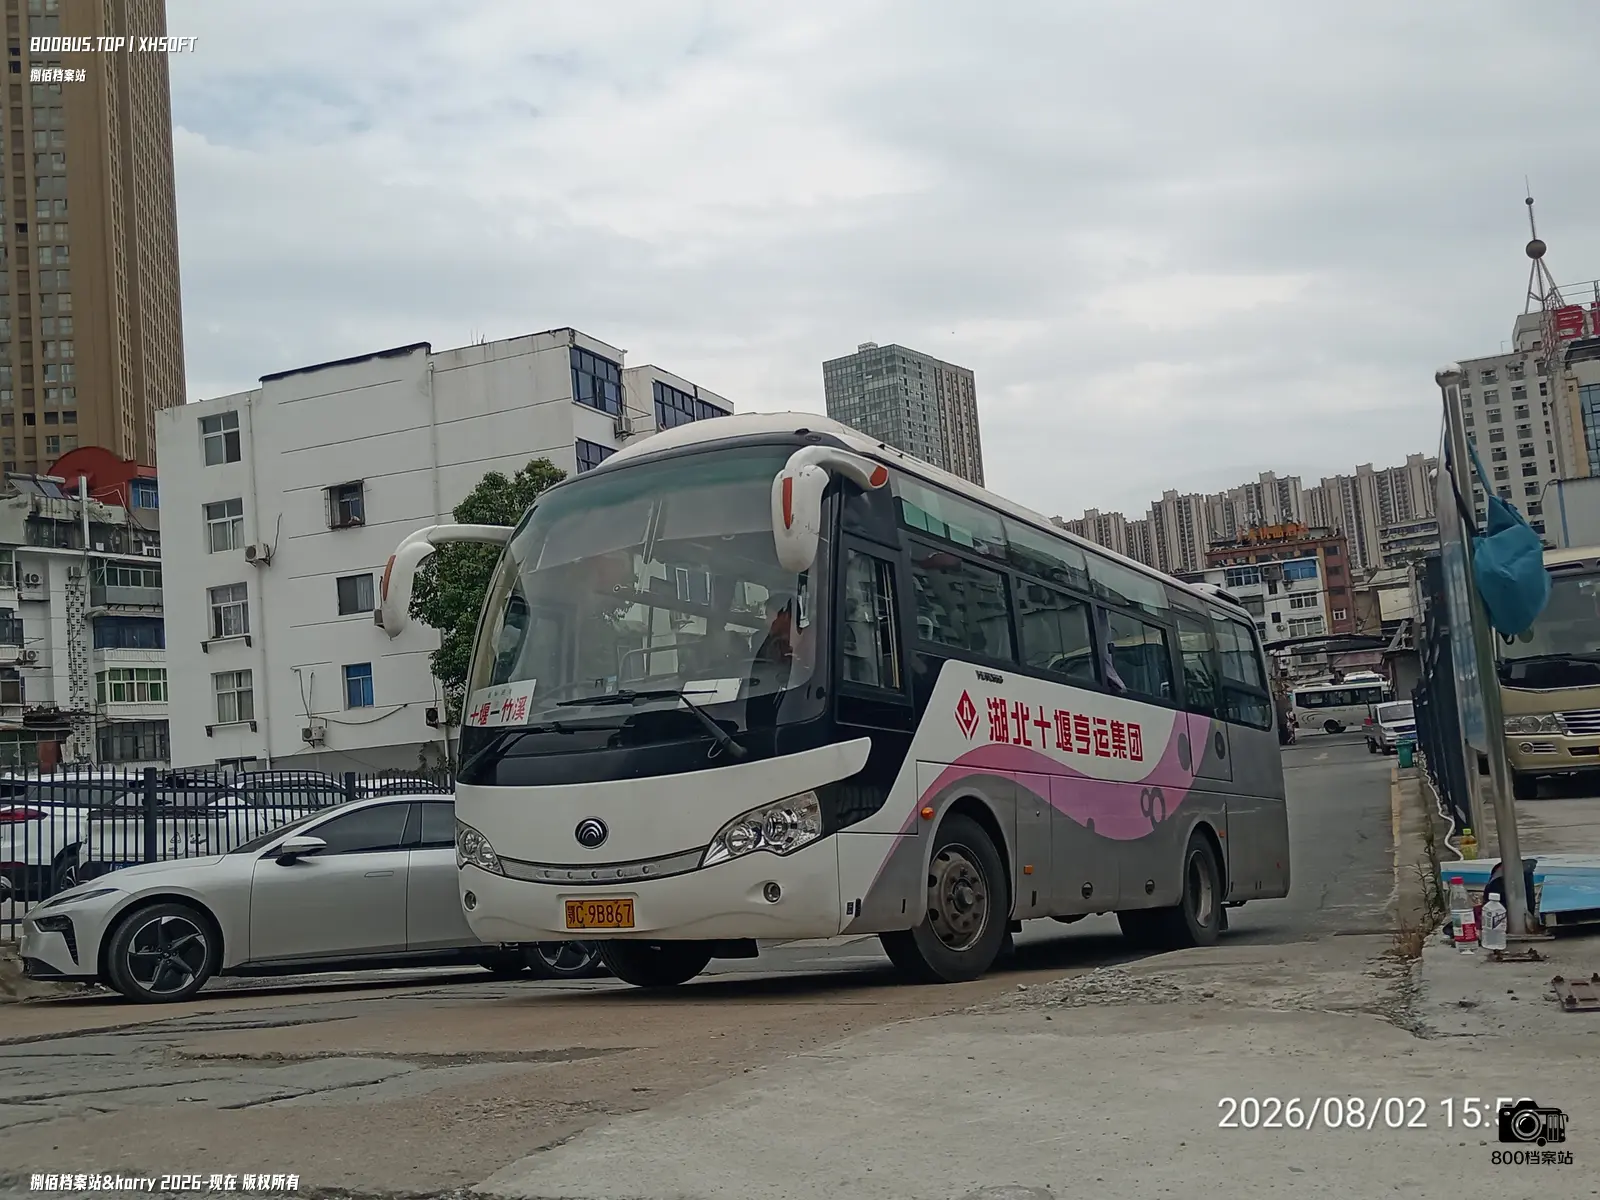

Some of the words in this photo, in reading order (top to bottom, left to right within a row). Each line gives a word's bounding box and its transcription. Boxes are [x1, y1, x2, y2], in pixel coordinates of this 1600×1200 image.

[986, 697, 1143, 762] 湖北十堰亨运集团
